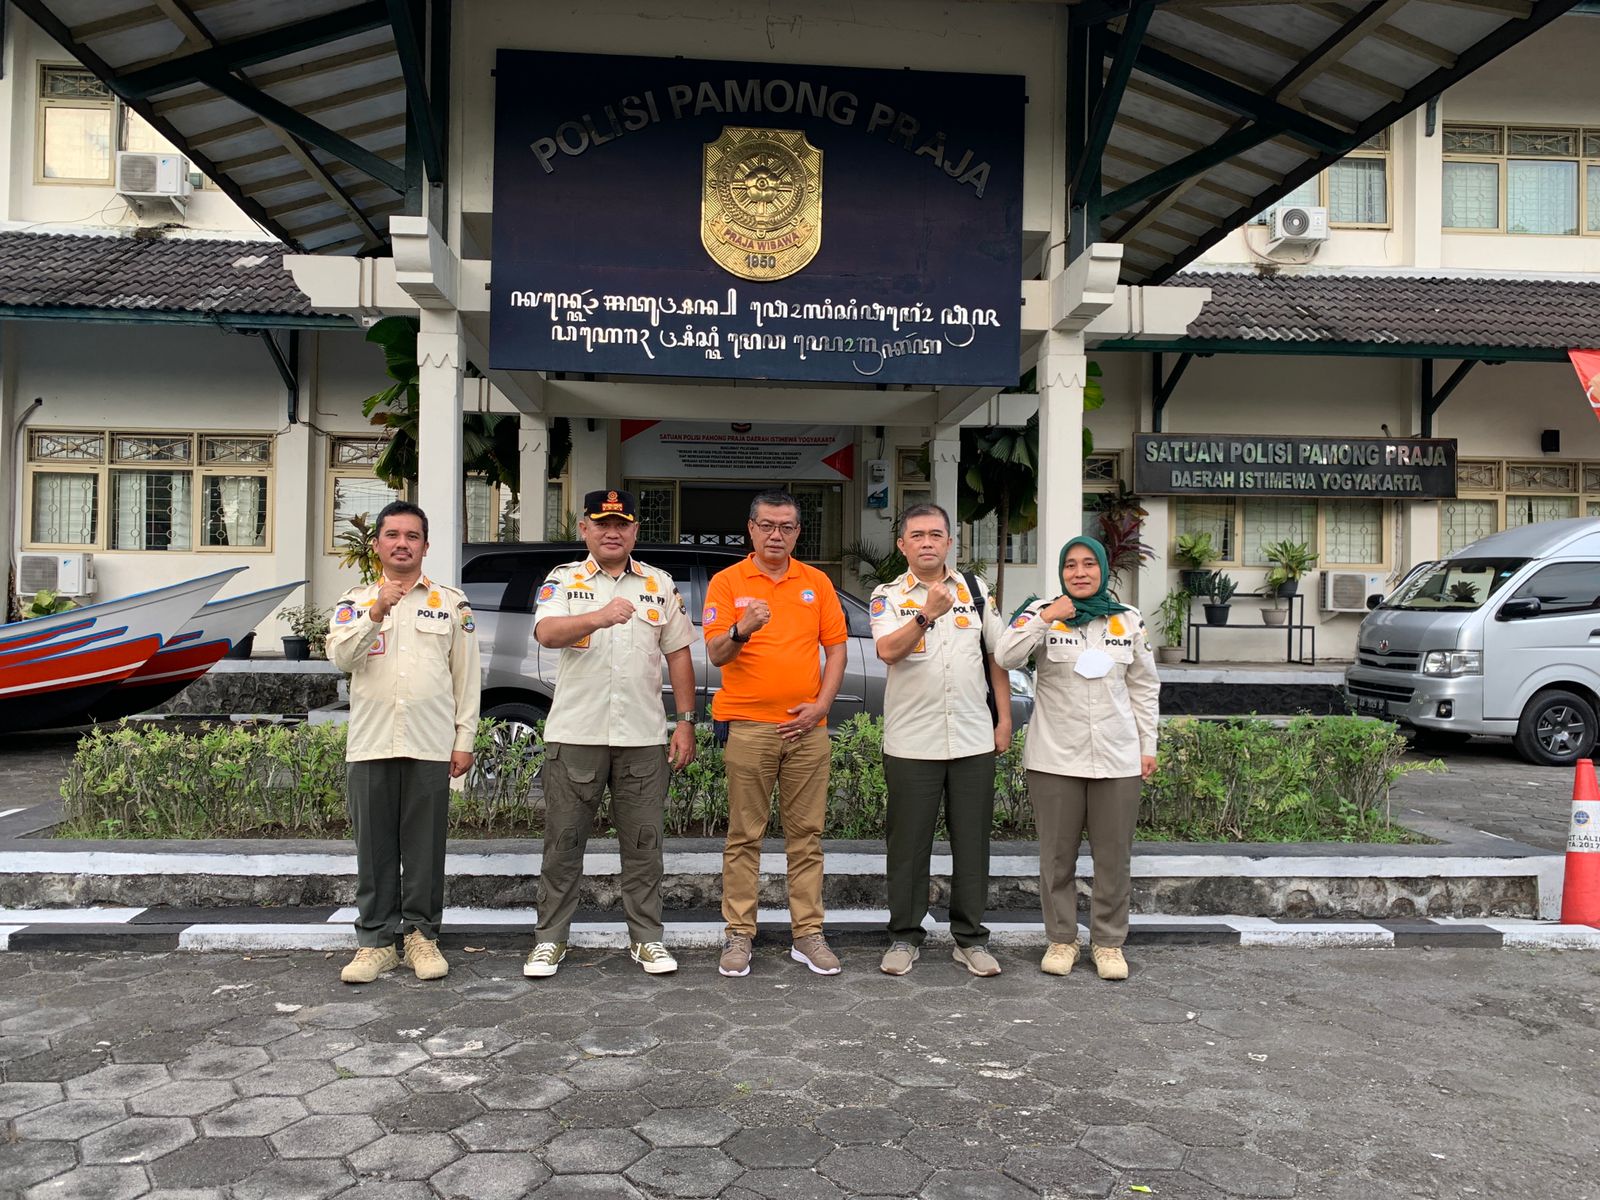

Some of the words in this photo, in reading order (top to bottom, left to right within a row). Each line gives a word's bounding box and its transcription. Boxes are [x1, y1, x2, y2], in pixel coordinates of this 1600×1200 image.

[530, 92, 661, 175] POLISI
[668, 78, 860, 127] PAMONG
[866, 102, 992, 199] PRAJA
[722, 228, 755, 250] PRAJA
[757, 232, 800, 251] WIBAWA
[744, 255, 777, 269] 1950
[727, 435, 745, 443] PRAJA
[1145, 441, 1224, 464] SATUAN
[1230, 442, 1292, 465] POLISI
[1299, 444, 1380, 466] PAMONG
[1385, 445, 1447, 467] PRAJA
[1171, 470, 1235, 489] DAERAH
[1240, 471, 1316, 490] ISTIMEWA
[1319, 473, 1423, 491] YOGYAKARTA
[566, 591, 595, 600] DELLY
[639, 594, 655, 603] POL
[657, 596, 666, 605] PP
[417, 609, 435, 619] POL
[437, 611, 449, 620] PP
[952, 605, 968, 614] POL
[1049, 637, 1078, 645] DINI
